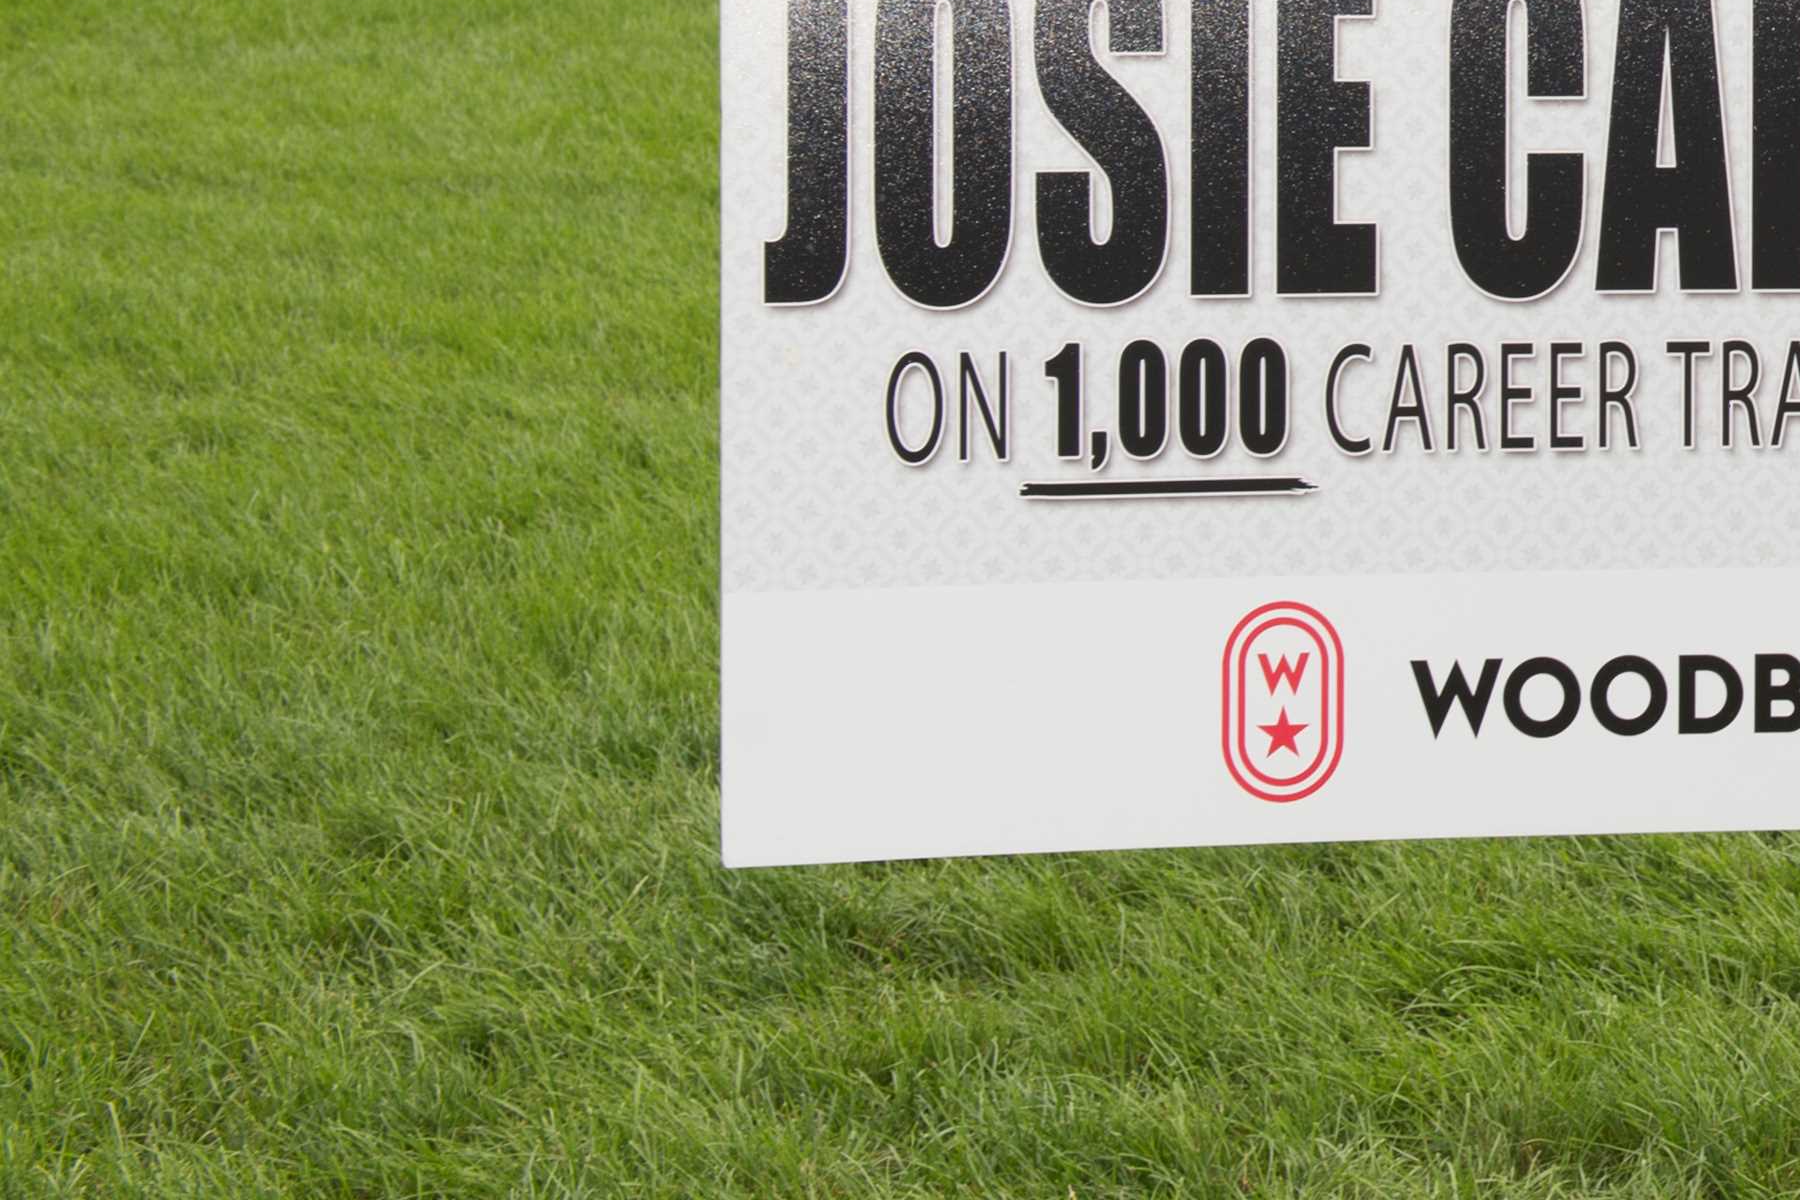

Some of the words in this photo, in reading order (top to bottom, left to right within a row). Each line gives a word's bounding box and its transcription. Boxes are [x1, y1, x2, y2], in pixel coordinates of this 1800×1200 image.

[886, 351, 1007, 463] ON
[1046, 336, 1287, 475] 1,000
[1325, 341, 1637, 453] CAREER
[1258, 653, 1309, 695] W
